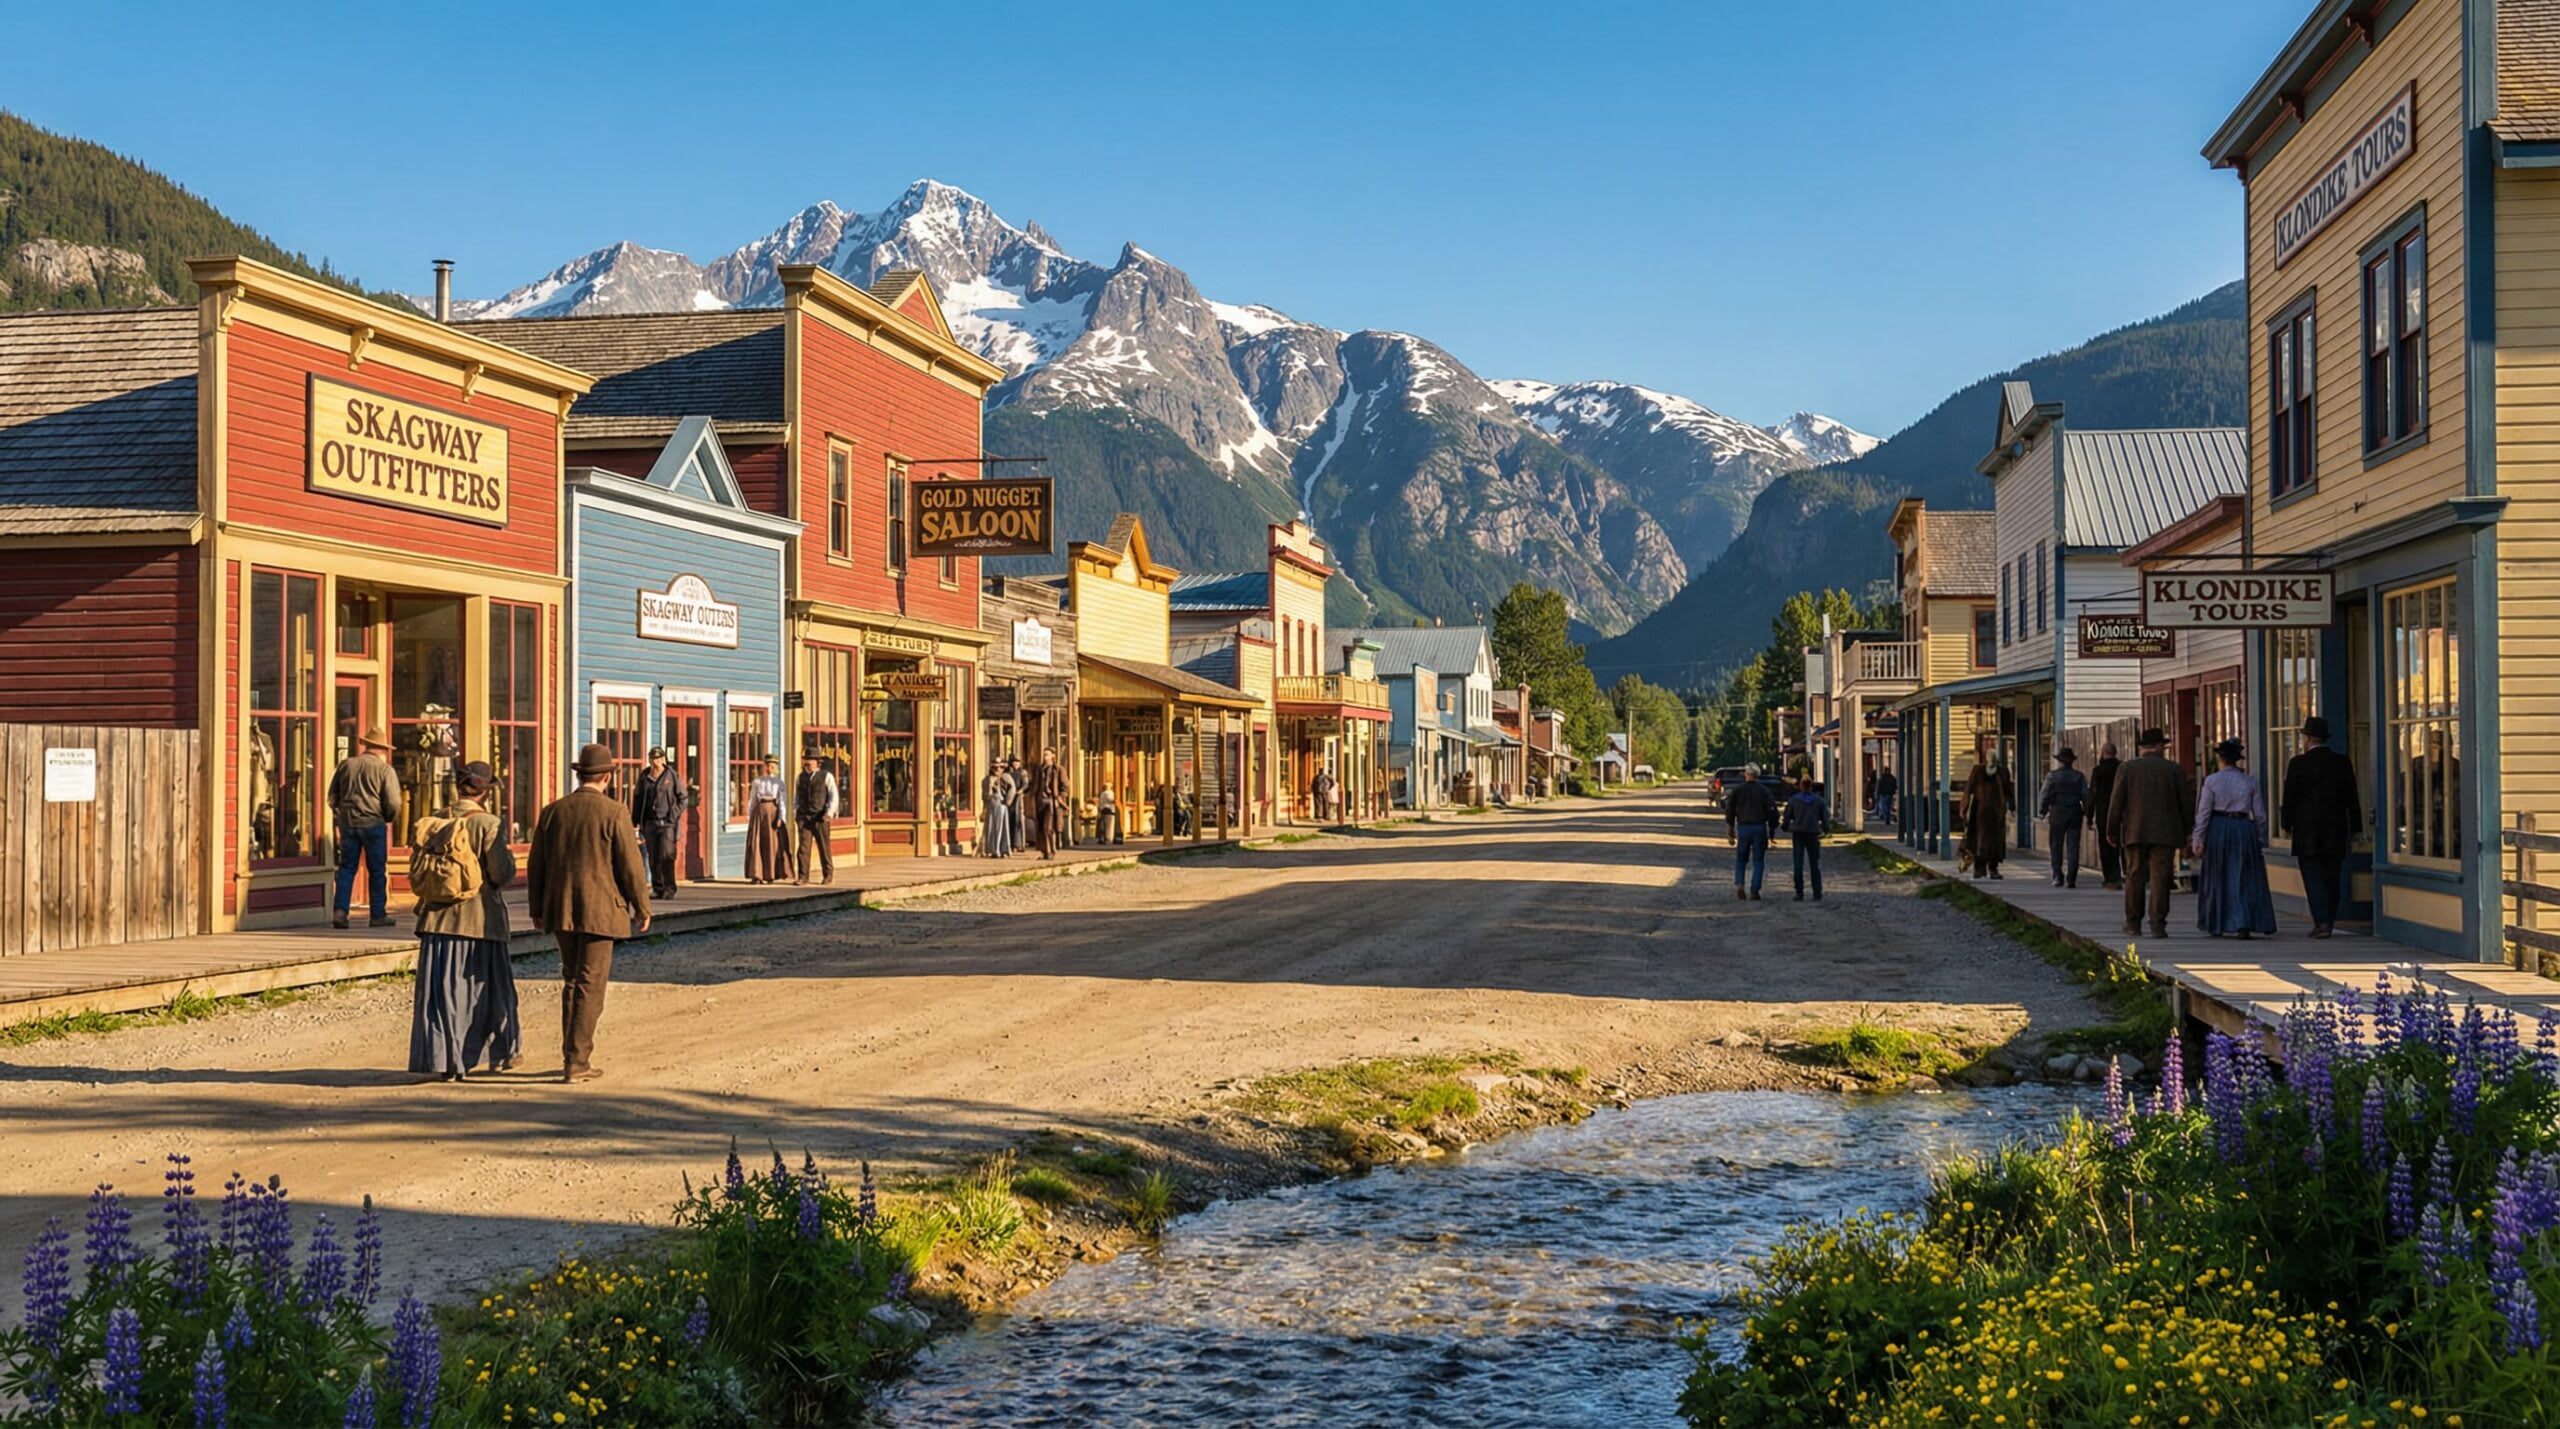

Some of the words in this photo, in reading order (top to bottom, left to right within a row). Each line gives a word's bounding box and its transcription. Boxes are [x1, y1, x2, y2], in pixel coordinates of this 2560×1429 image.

[2278, 160, 2348, 257] KLONDIKE
[2352, 105, 2407, 190] TOURS
[346, 398, 482, 463] SKAGWAY
[321, 440, 501, 511] OUTFITTERS
[921, 489, 967, 508] GOLD
[973, 487, 1042, 507] NUGGET
[921, 510, 1042, 544] SALOON
[2153, 579, 2323, 602] KLONDIKE
[643, 598, 693, 623] SKAGWAY
[2188, 604, 2288, 621] TOURS
